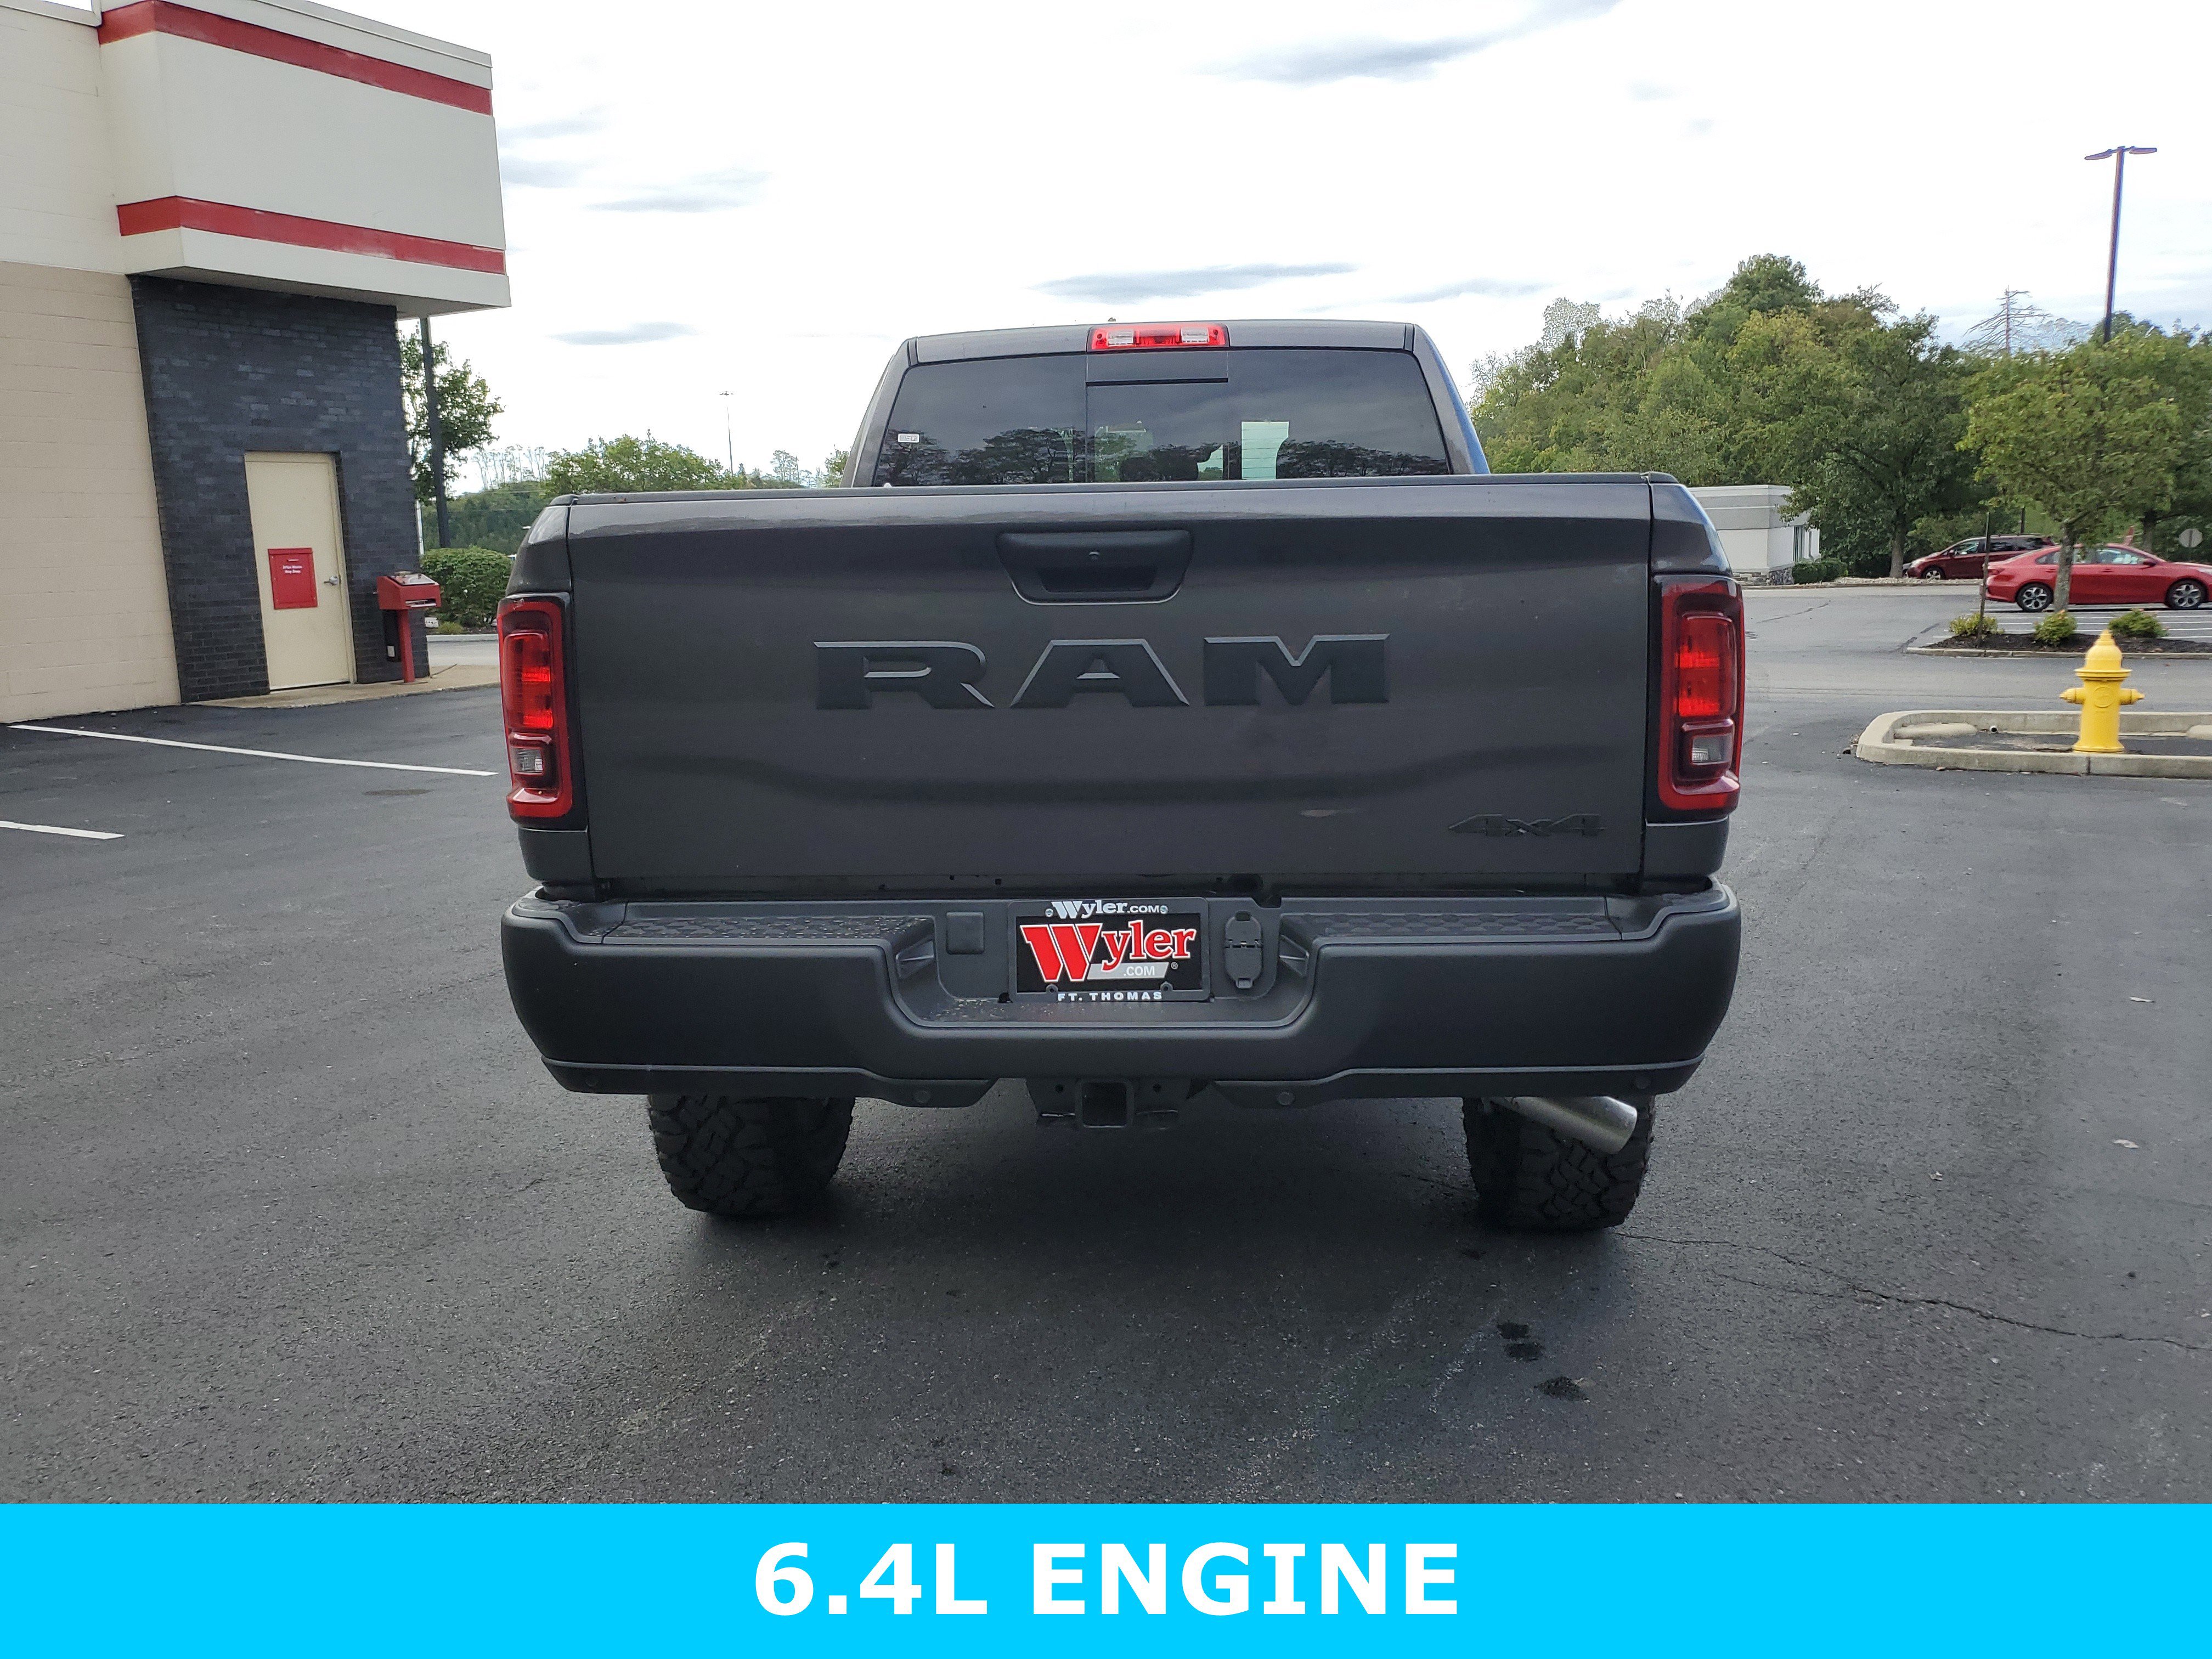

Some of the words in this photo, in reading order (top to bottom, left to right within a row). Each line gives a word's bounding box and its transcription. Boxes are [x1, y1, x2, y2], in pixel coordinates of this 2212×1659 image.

[814, 634, 1390, 710] RAM
[1020, 919, 1197, 982] Wyler
[1123, 966, 1155, 977] .COM
[1058, 993, 1082, 1001] FT.
[1089, 991, 1163, 1001] THOMAS
